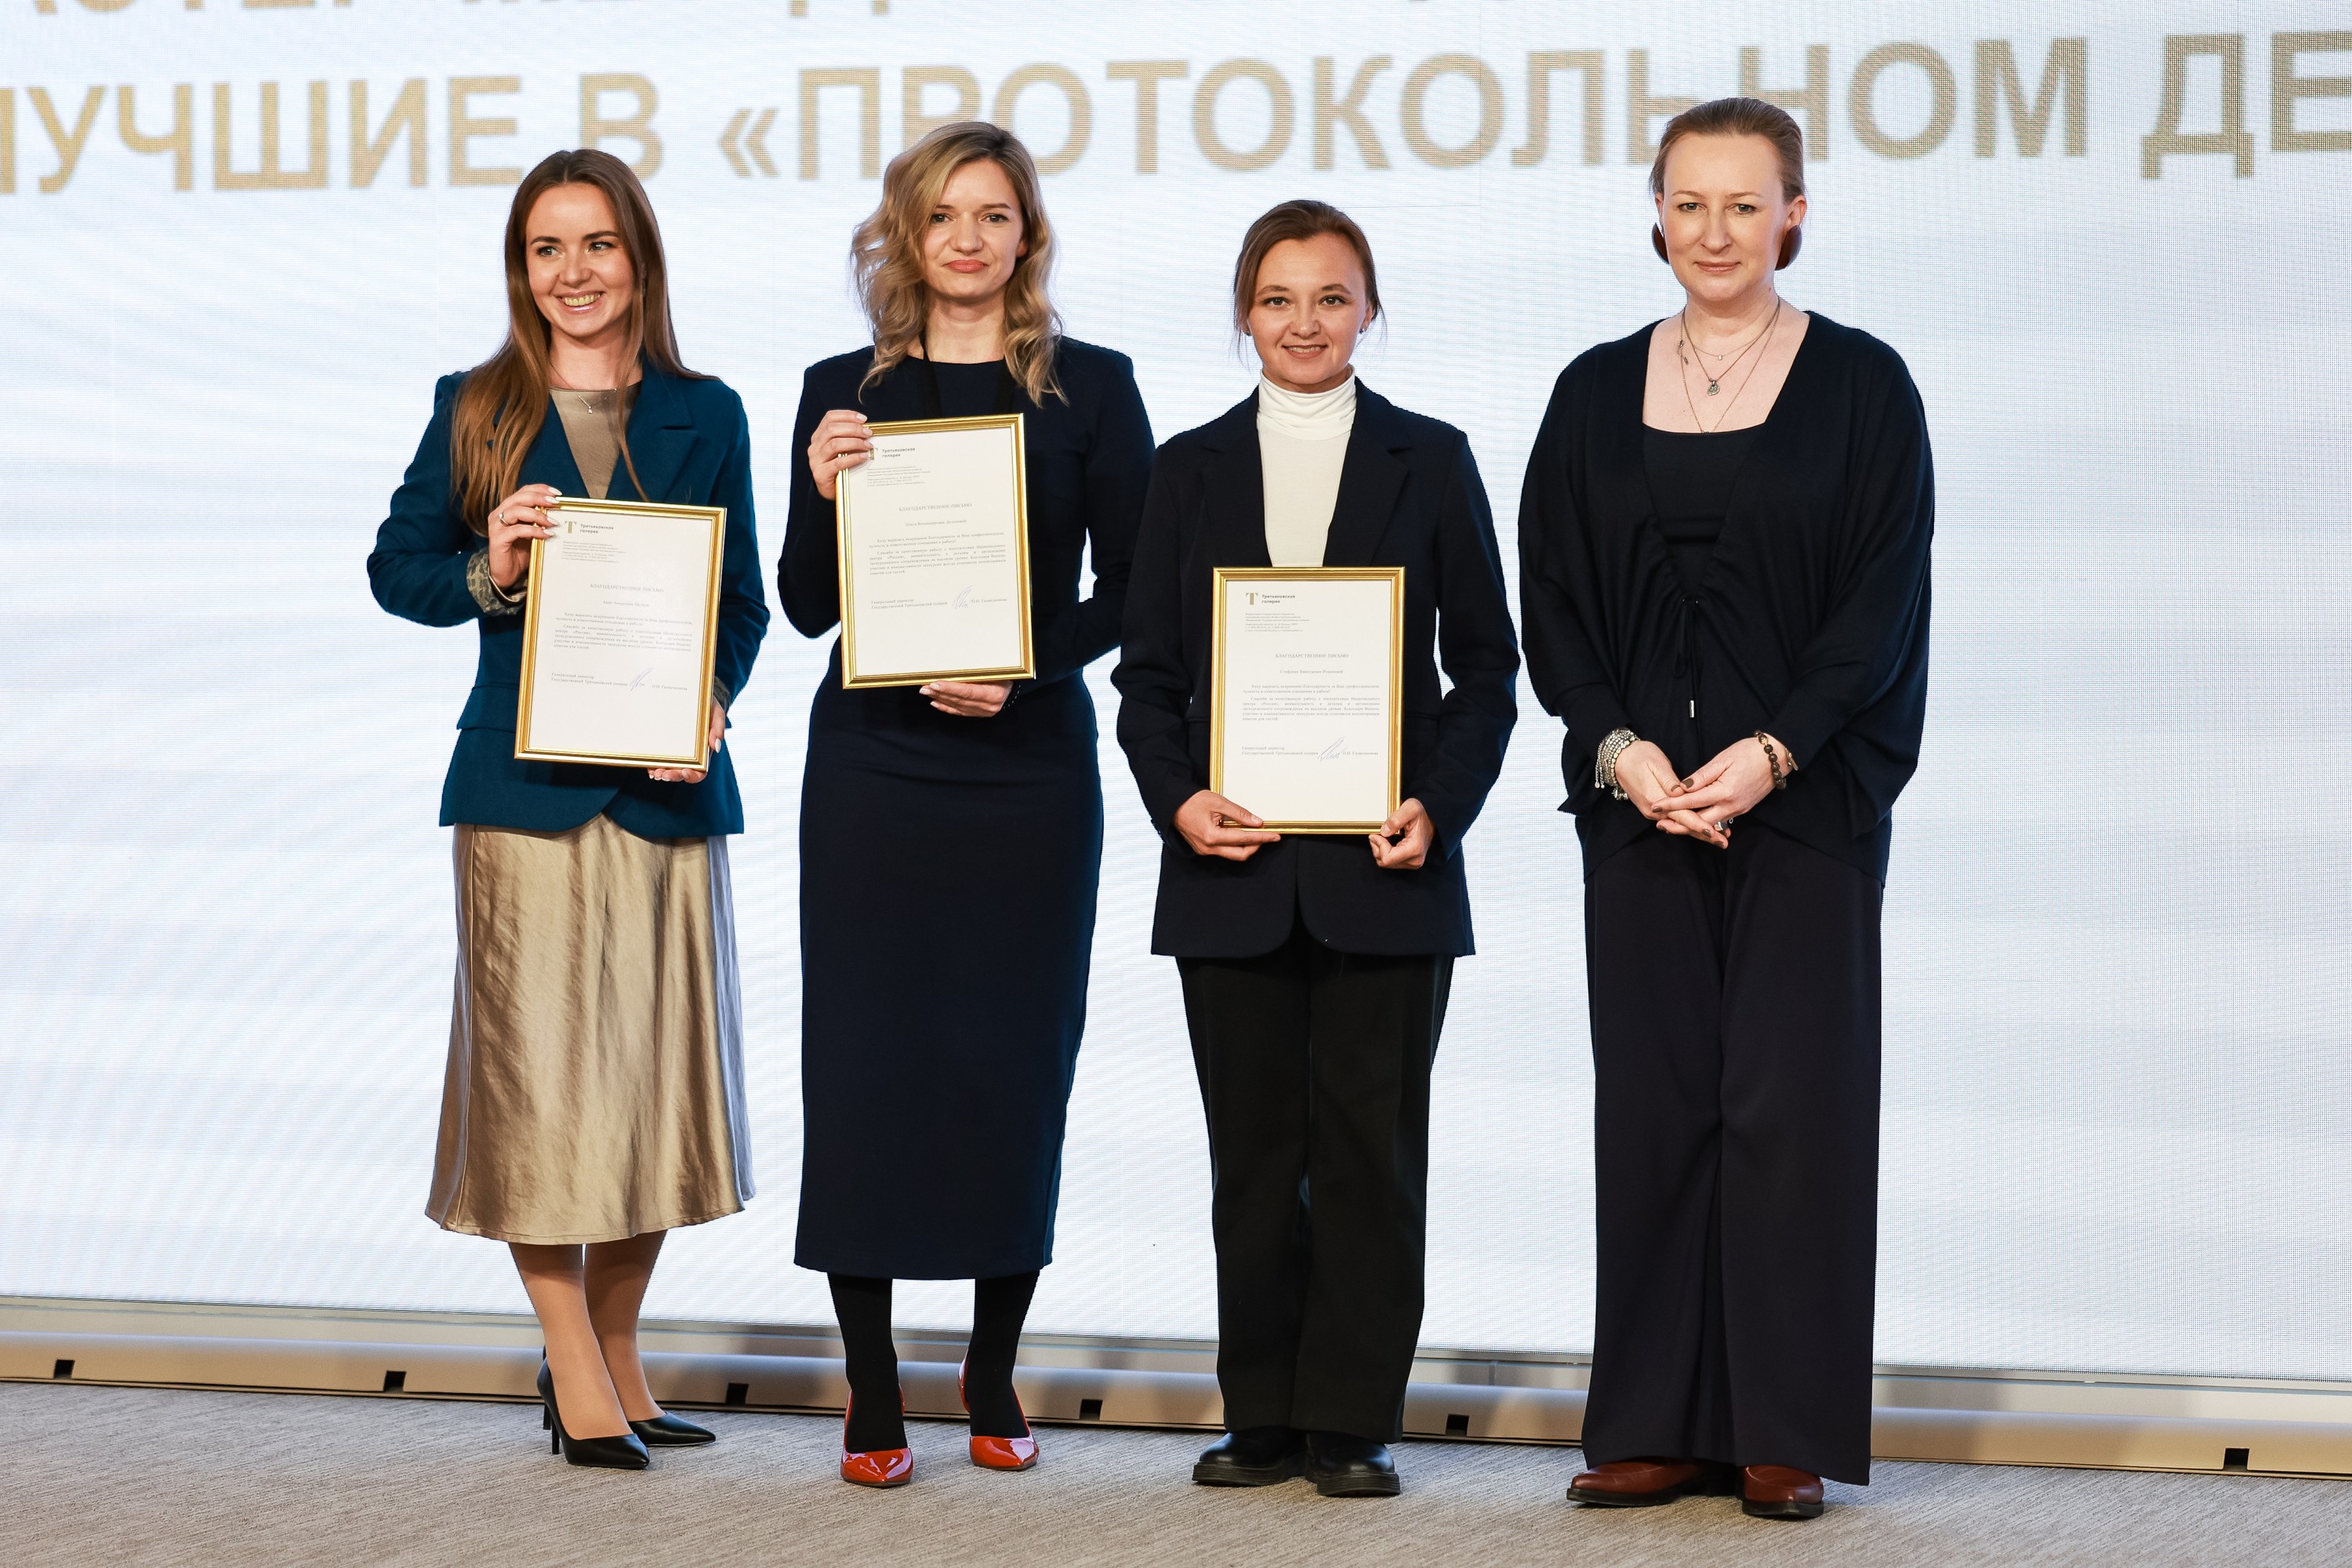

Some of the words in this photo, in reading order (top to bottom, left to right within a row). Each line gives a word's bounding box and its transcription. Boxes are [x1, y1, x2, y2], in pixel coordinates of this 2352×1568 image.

[0, 75, 523, 194] УЧШИЕ
[579, 72, 663, 185] В
[2140, 31, 2352, 180] ДЕ
